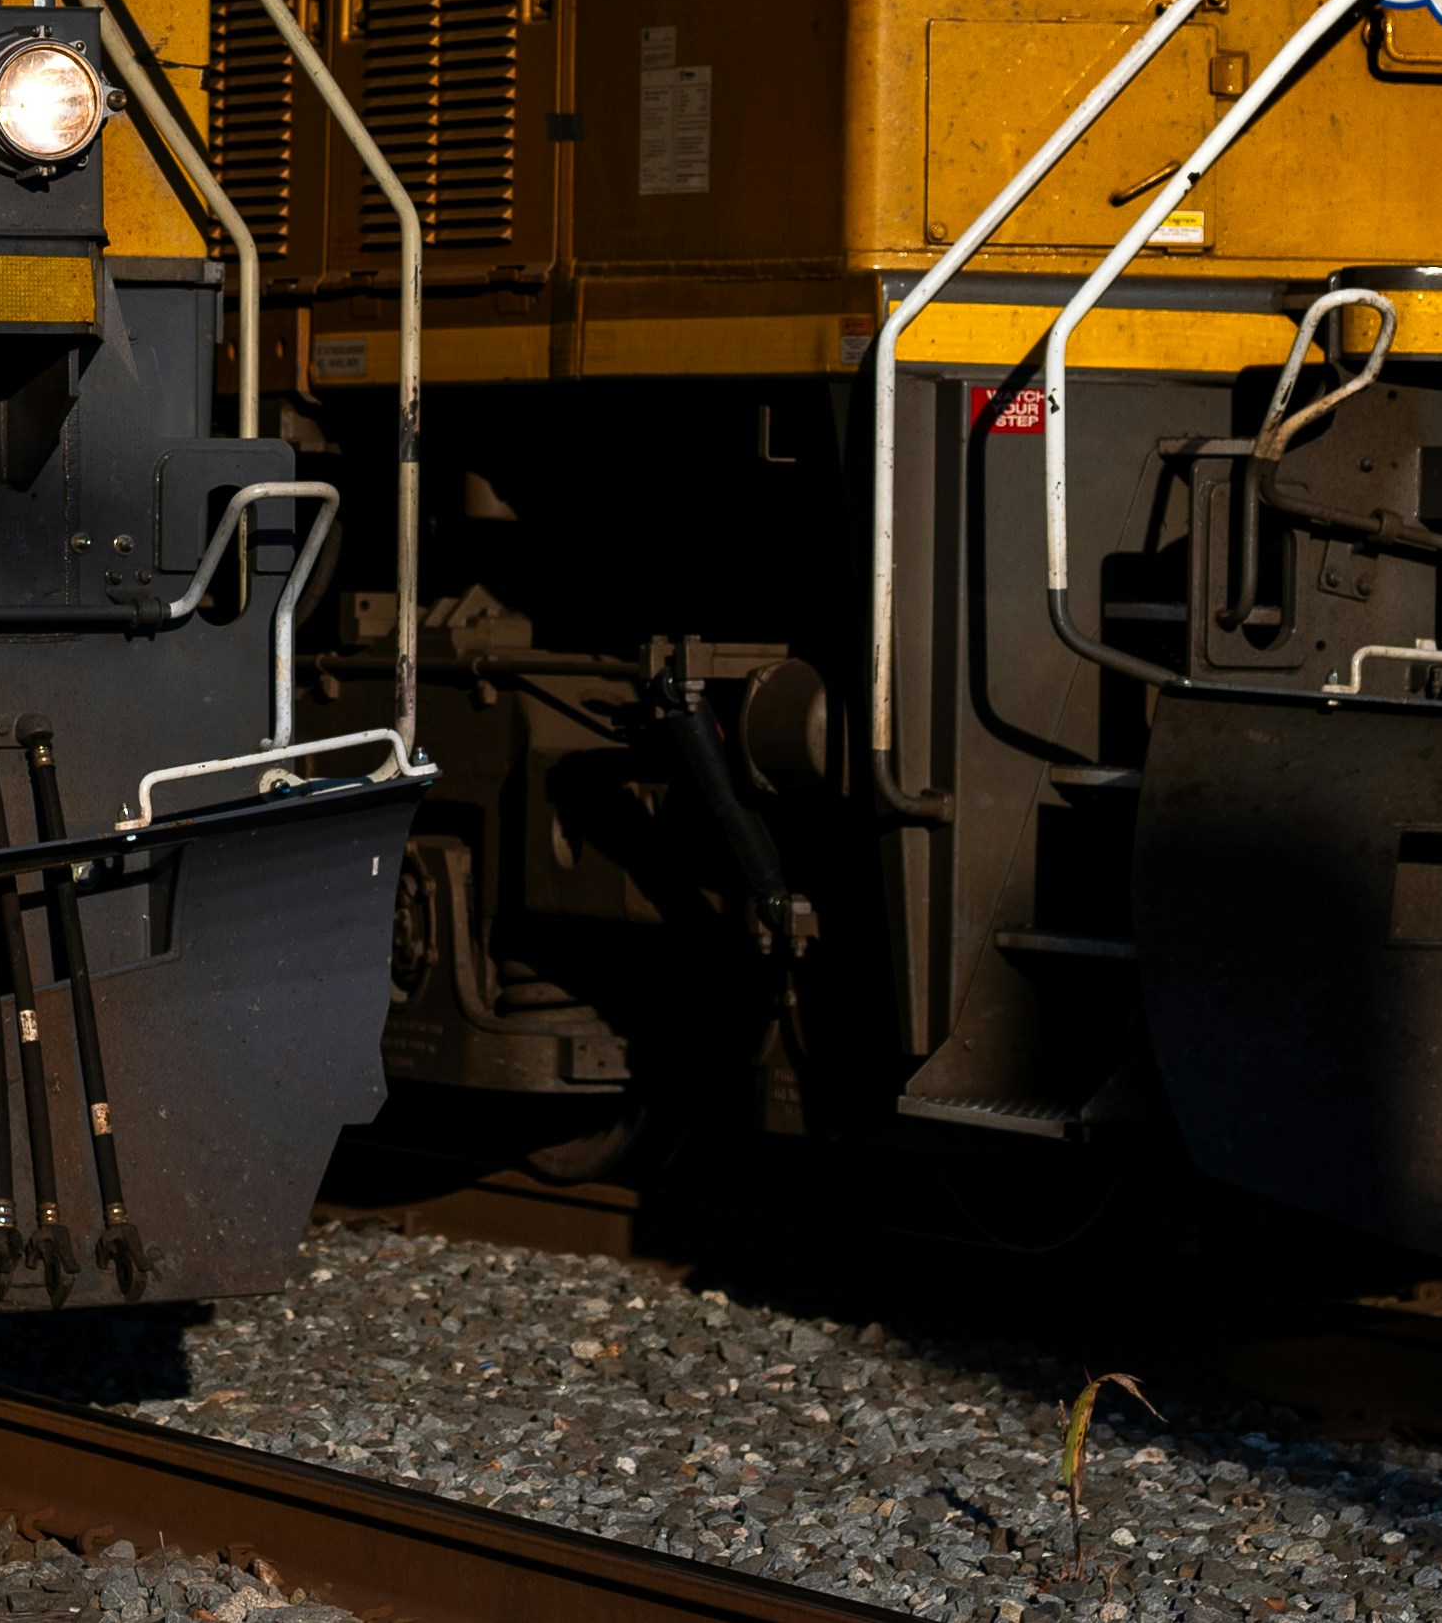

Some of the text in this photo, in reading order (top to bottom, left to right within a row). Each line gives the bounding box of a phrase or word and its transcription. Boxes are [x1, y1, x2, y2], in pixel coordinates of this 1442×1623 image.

[986, 389, 1046, 403] WATCH
[992, 402, 1039, 416] YOUR
[994, 415, 1039, 427] STEP
